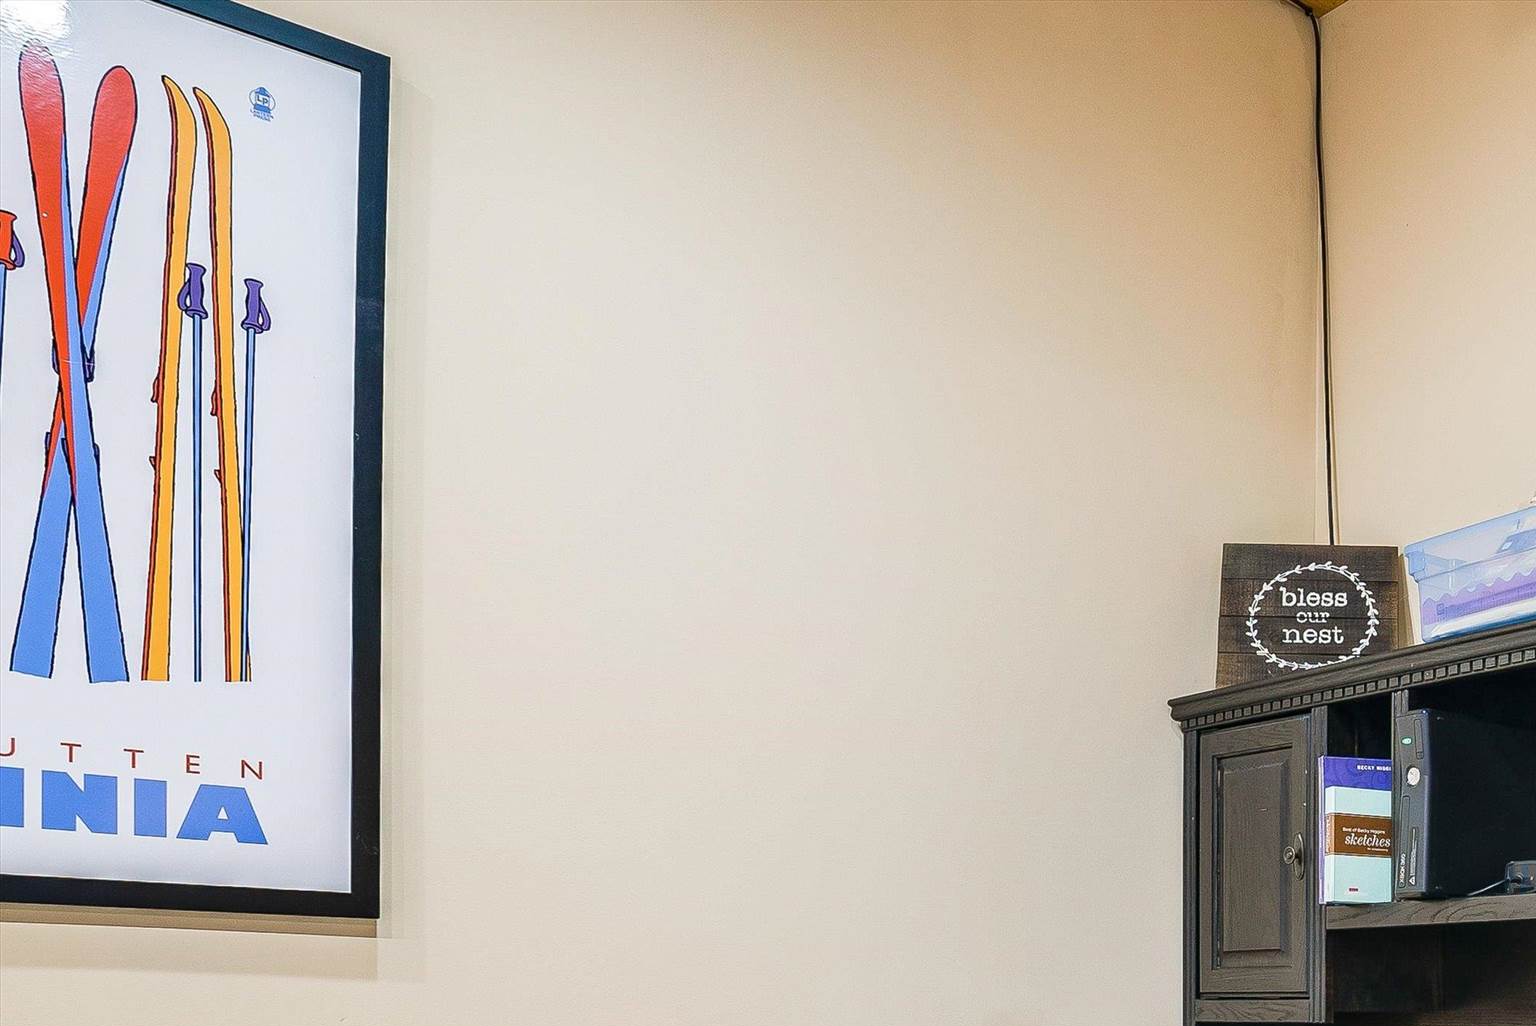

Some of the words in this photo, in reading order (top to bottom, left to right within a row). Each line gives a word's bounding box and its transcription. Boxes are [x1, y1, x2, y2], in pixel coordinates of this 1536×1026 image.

[1279, 586, 1348, 607] bless
[1296, 611, 1330, 624] our
[1282, 626, 1345, 644] nest
[1344, 833, 1391, 848] sketches
